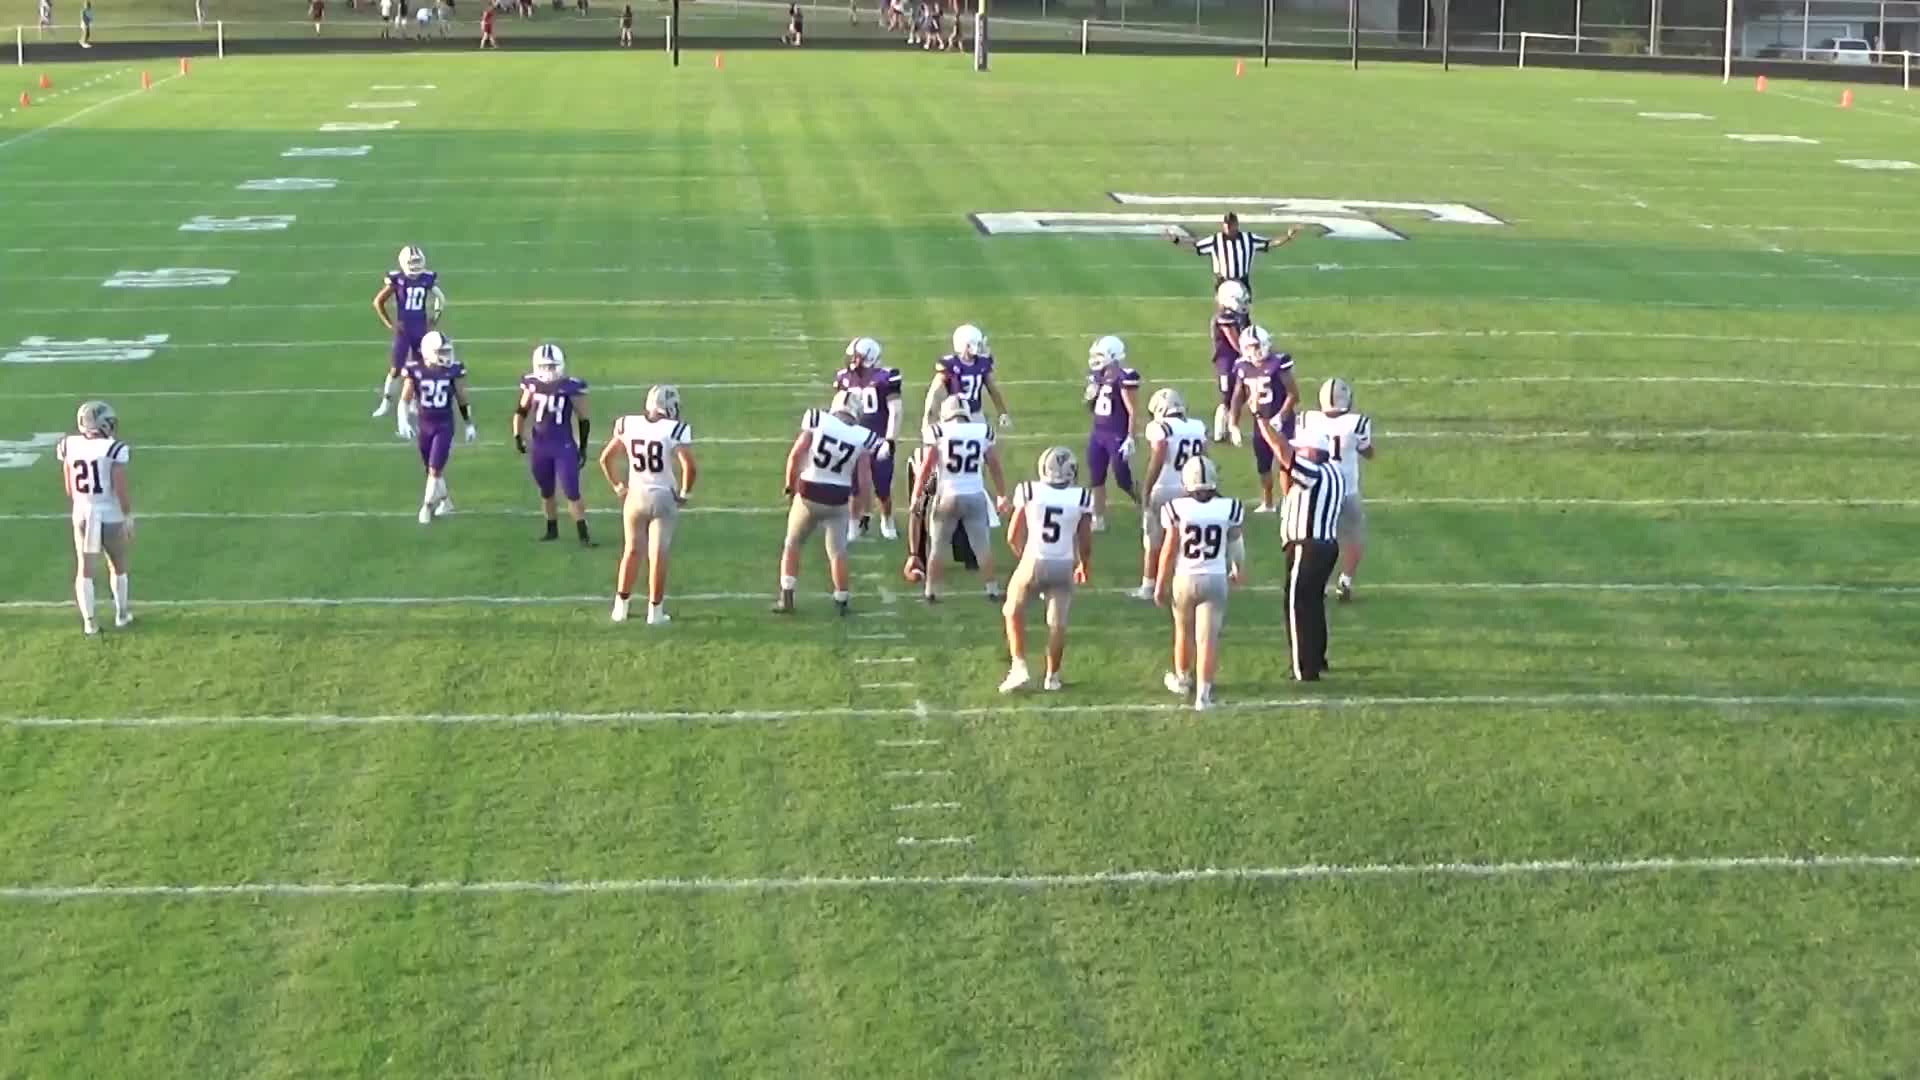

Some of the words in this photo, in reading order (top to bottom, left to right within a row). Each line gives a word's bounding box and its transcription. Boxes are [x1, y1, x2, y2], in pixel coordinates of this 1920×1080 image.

[404, 286, 426, 310] 10
[419, 379, 451, 408] 26
[960, 374, 984, 401] 31
[532, 392, 566, 425] 74
[630, 439, 664, 473] 58
[813, 433, 856, 474] 57
[946, 438, 981, 473] 52
[73, 458, 104, 495] 21
[1041, 506, 1064, 544] 5
[1184, 523, 1223, 561] 29
